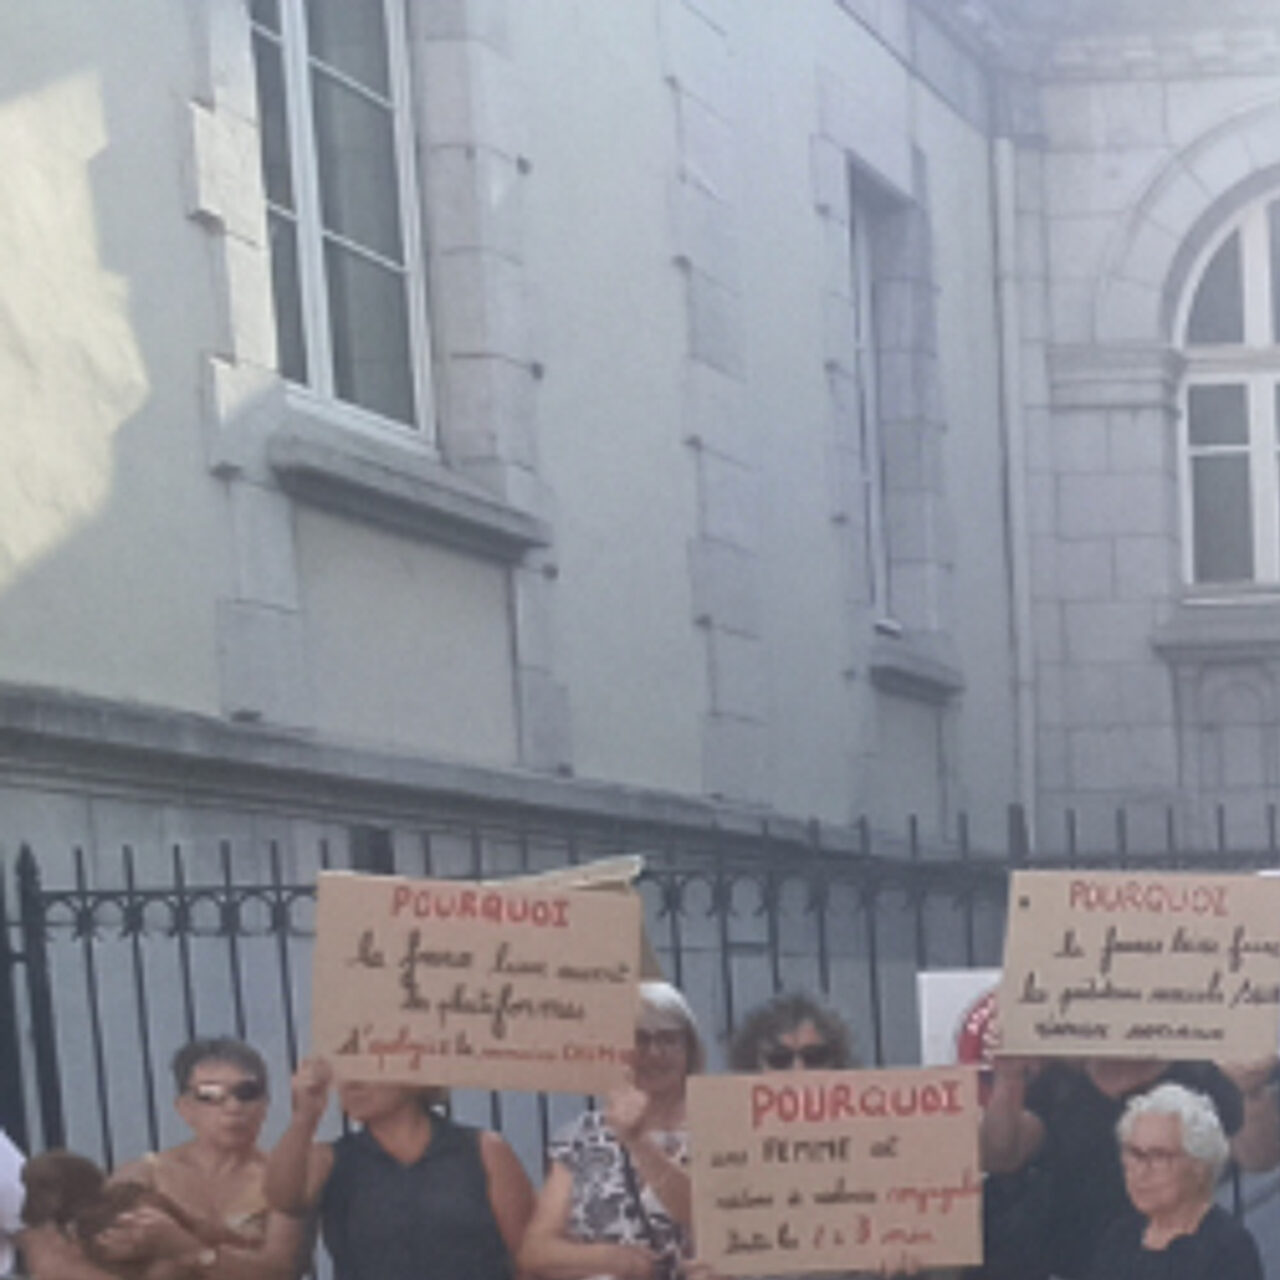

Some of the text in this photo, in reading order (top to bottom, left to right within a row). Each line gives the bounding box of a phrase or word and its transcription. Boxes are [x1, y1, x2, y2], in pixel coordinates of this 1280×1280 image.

[389, 885, 569, 927] POURQUOI
[1069, 880, 1229, 917] POURQUOI
[752, 1080, 964, 1128] POURQUOI
[762, 1136, 852, 1163] FEMME
